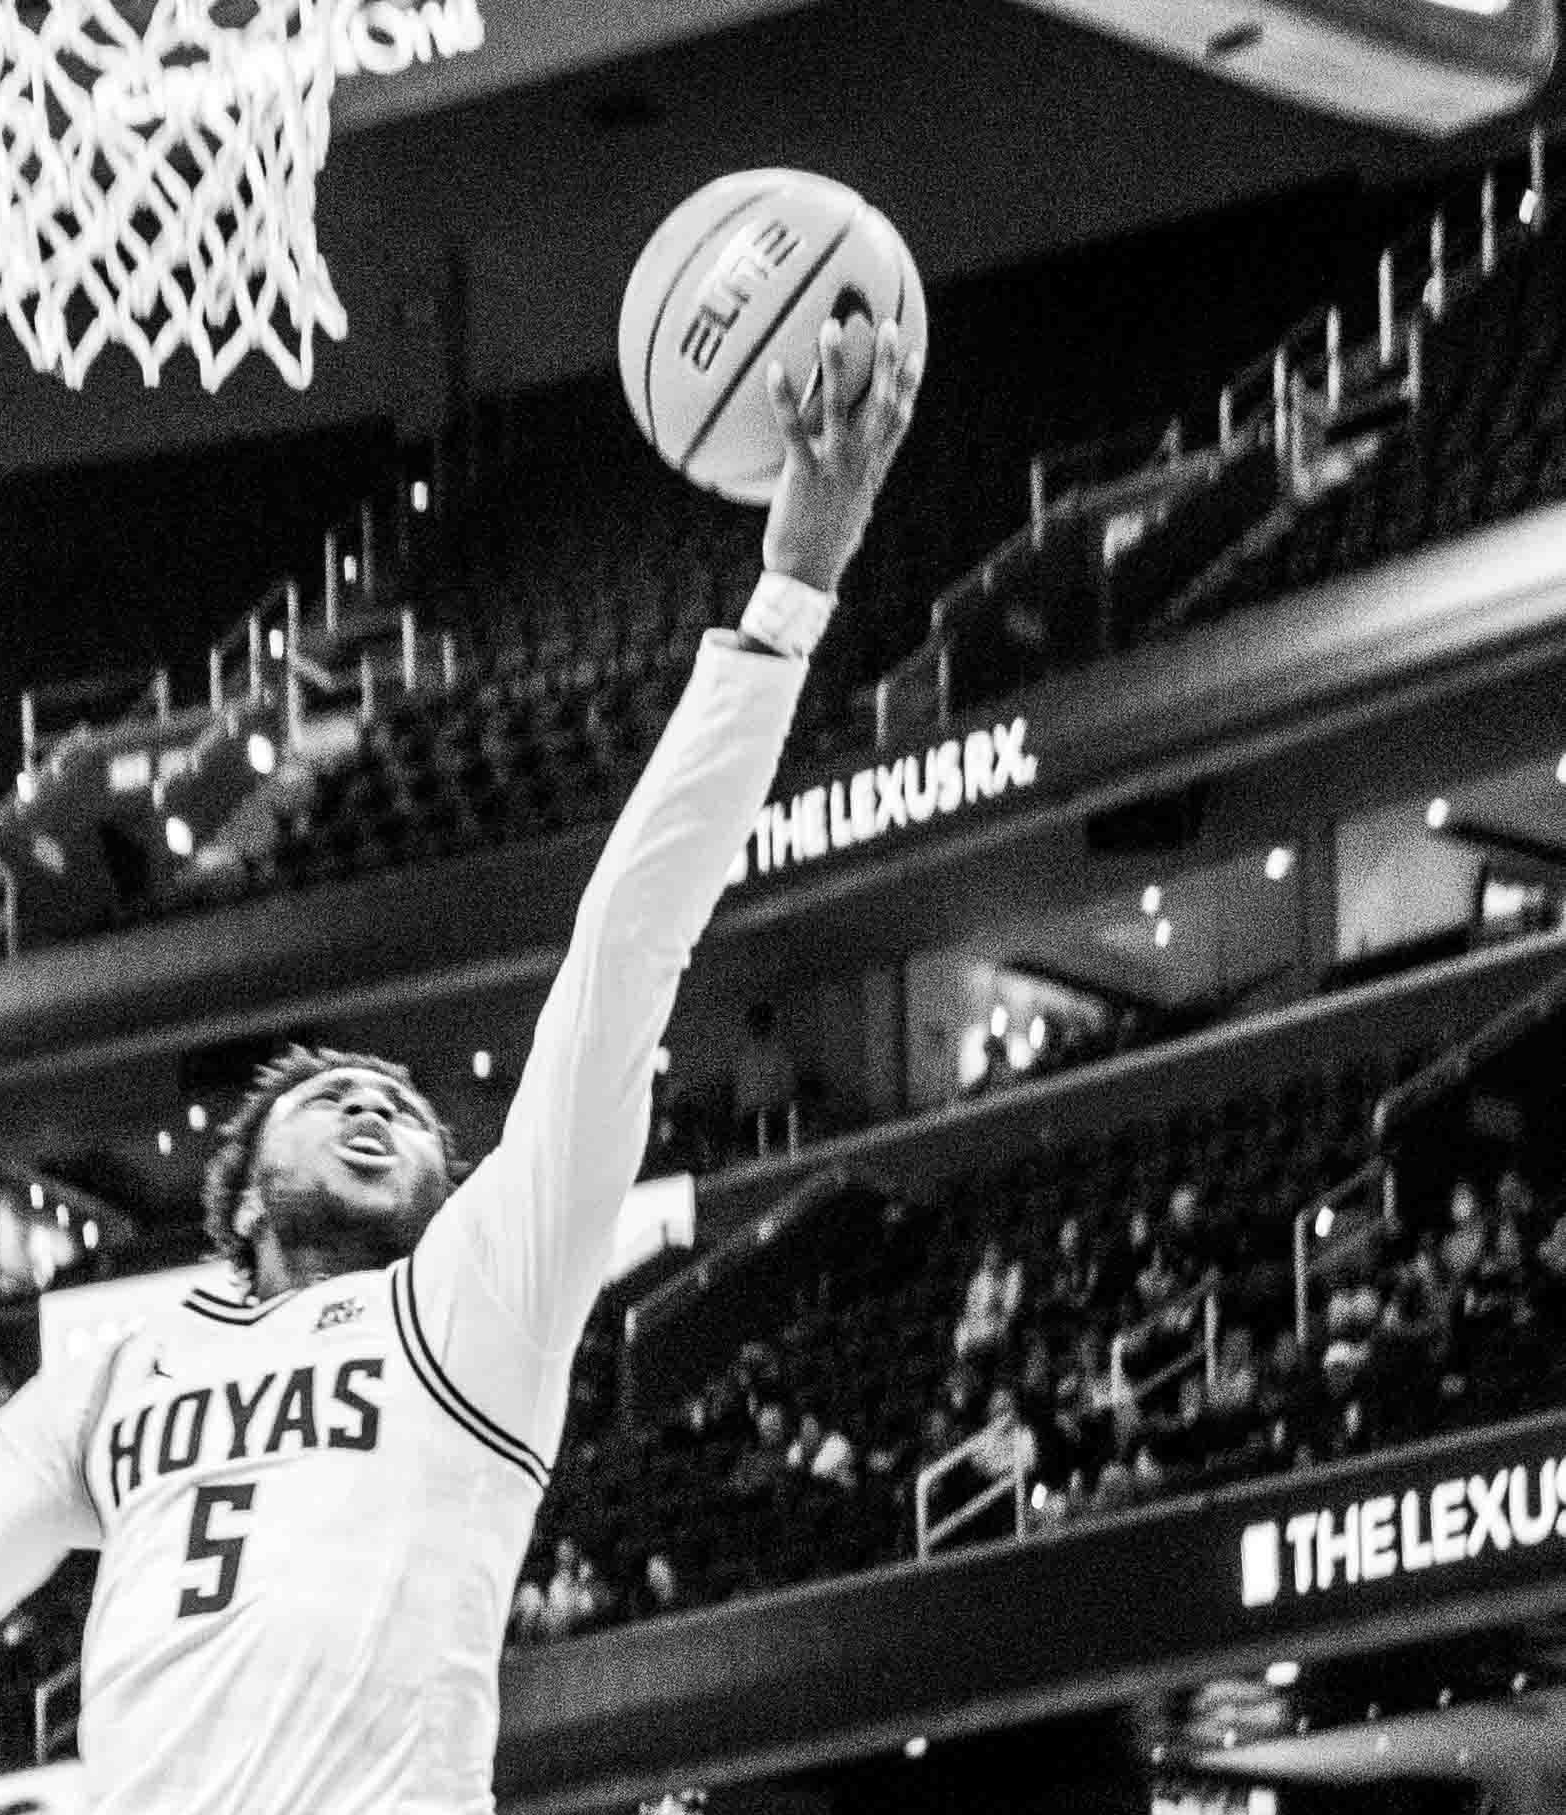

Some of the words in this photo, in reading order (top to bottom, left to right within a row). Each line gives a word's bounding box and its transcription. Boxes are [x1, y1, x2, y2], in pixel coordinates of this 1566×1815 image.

[109, 1358, 385, 1508] HOYAS
[177, 1483, 257, 1619] 5
[1285, 1495, 1397, 1594] THE
